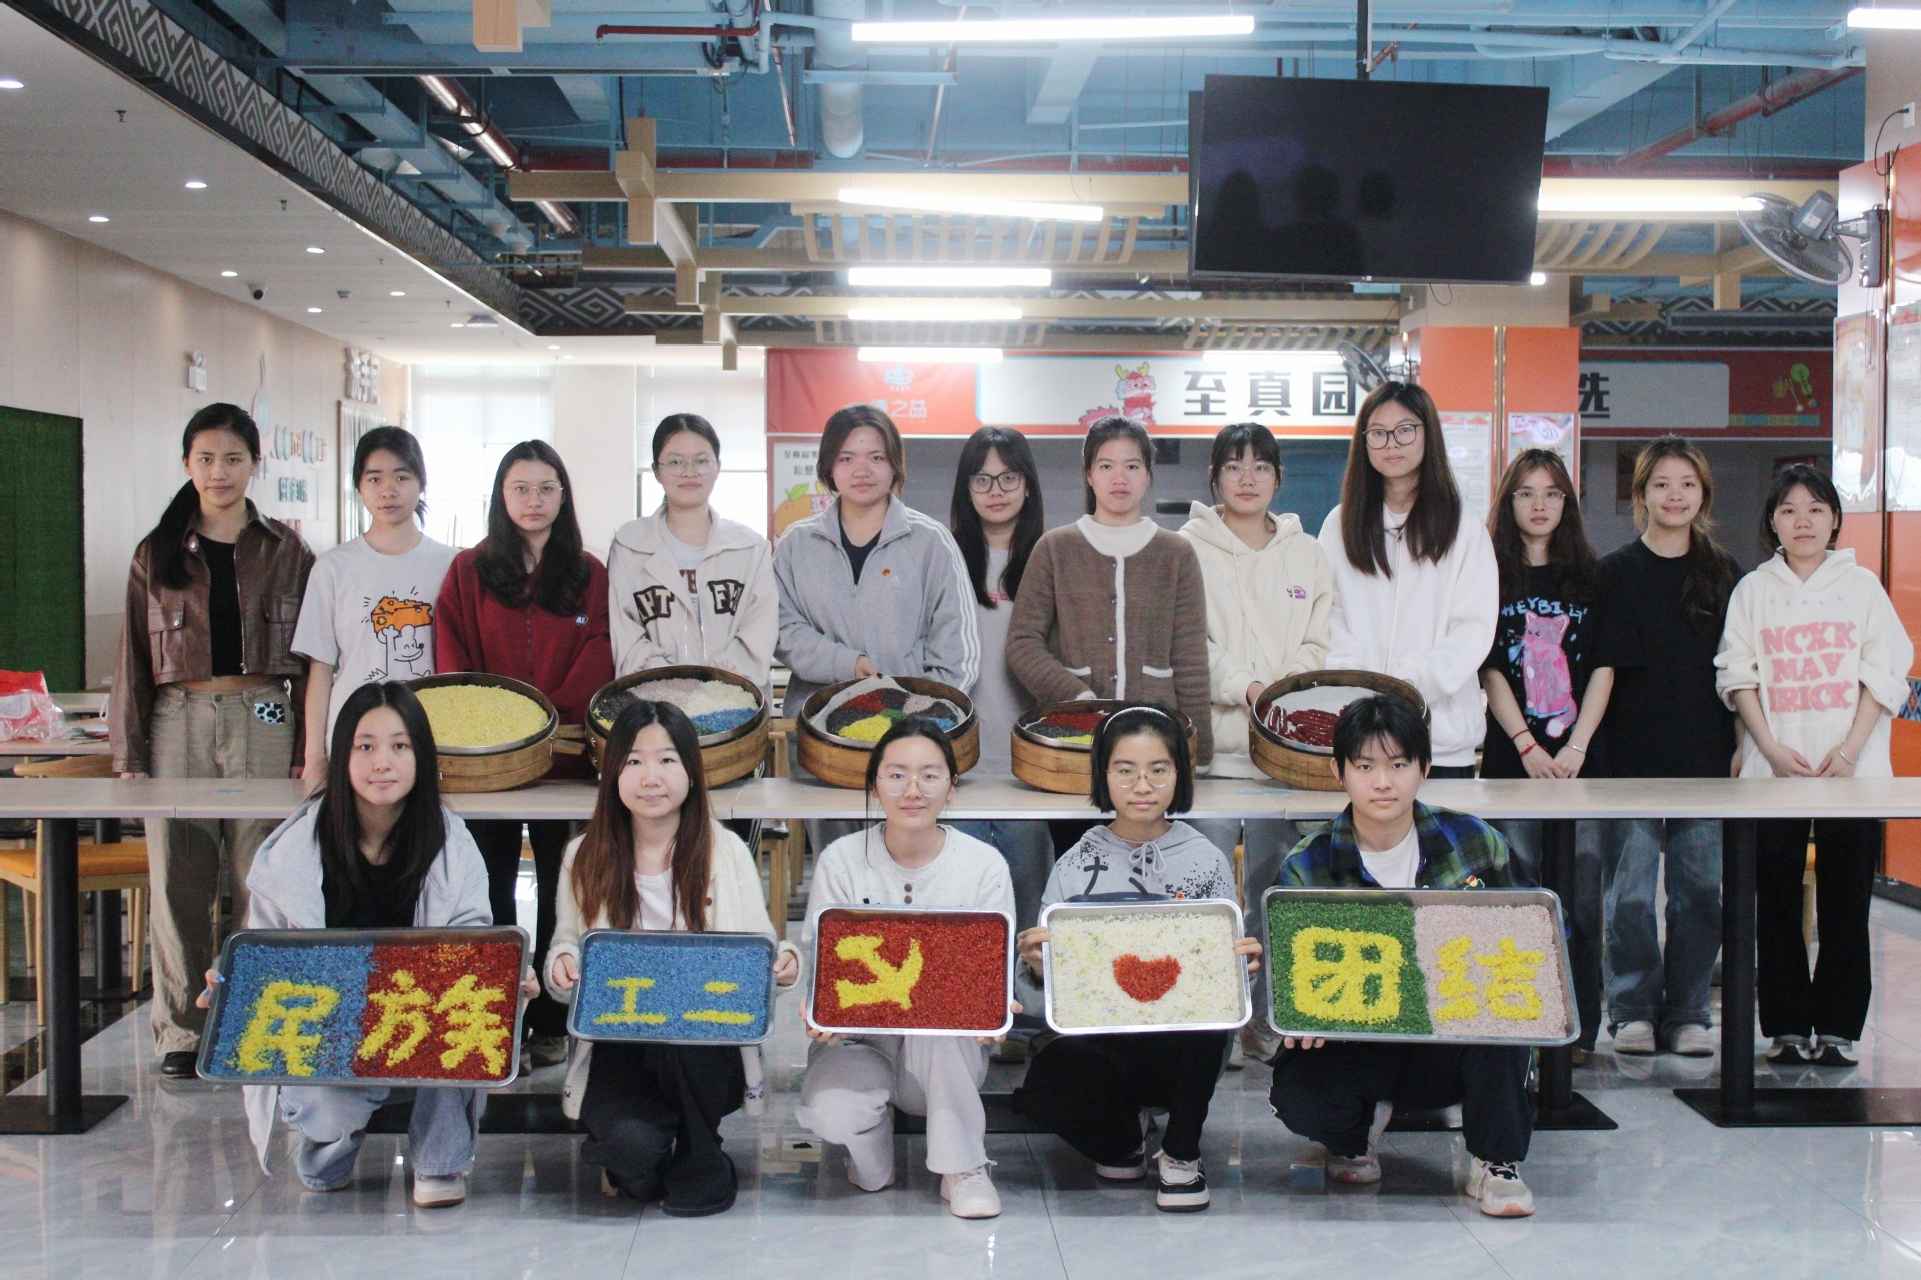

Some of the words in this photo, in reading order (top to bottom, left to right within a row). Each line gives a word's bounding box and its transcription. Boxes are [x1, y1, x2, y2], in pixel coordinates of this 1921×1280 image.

[1184, 370, 1356, 416] 至真园
[1771, 653, 1844, 683] MAV
[1290, 926, 1544, 1024] 团结
[234, 969, 511, 1076] 民族
